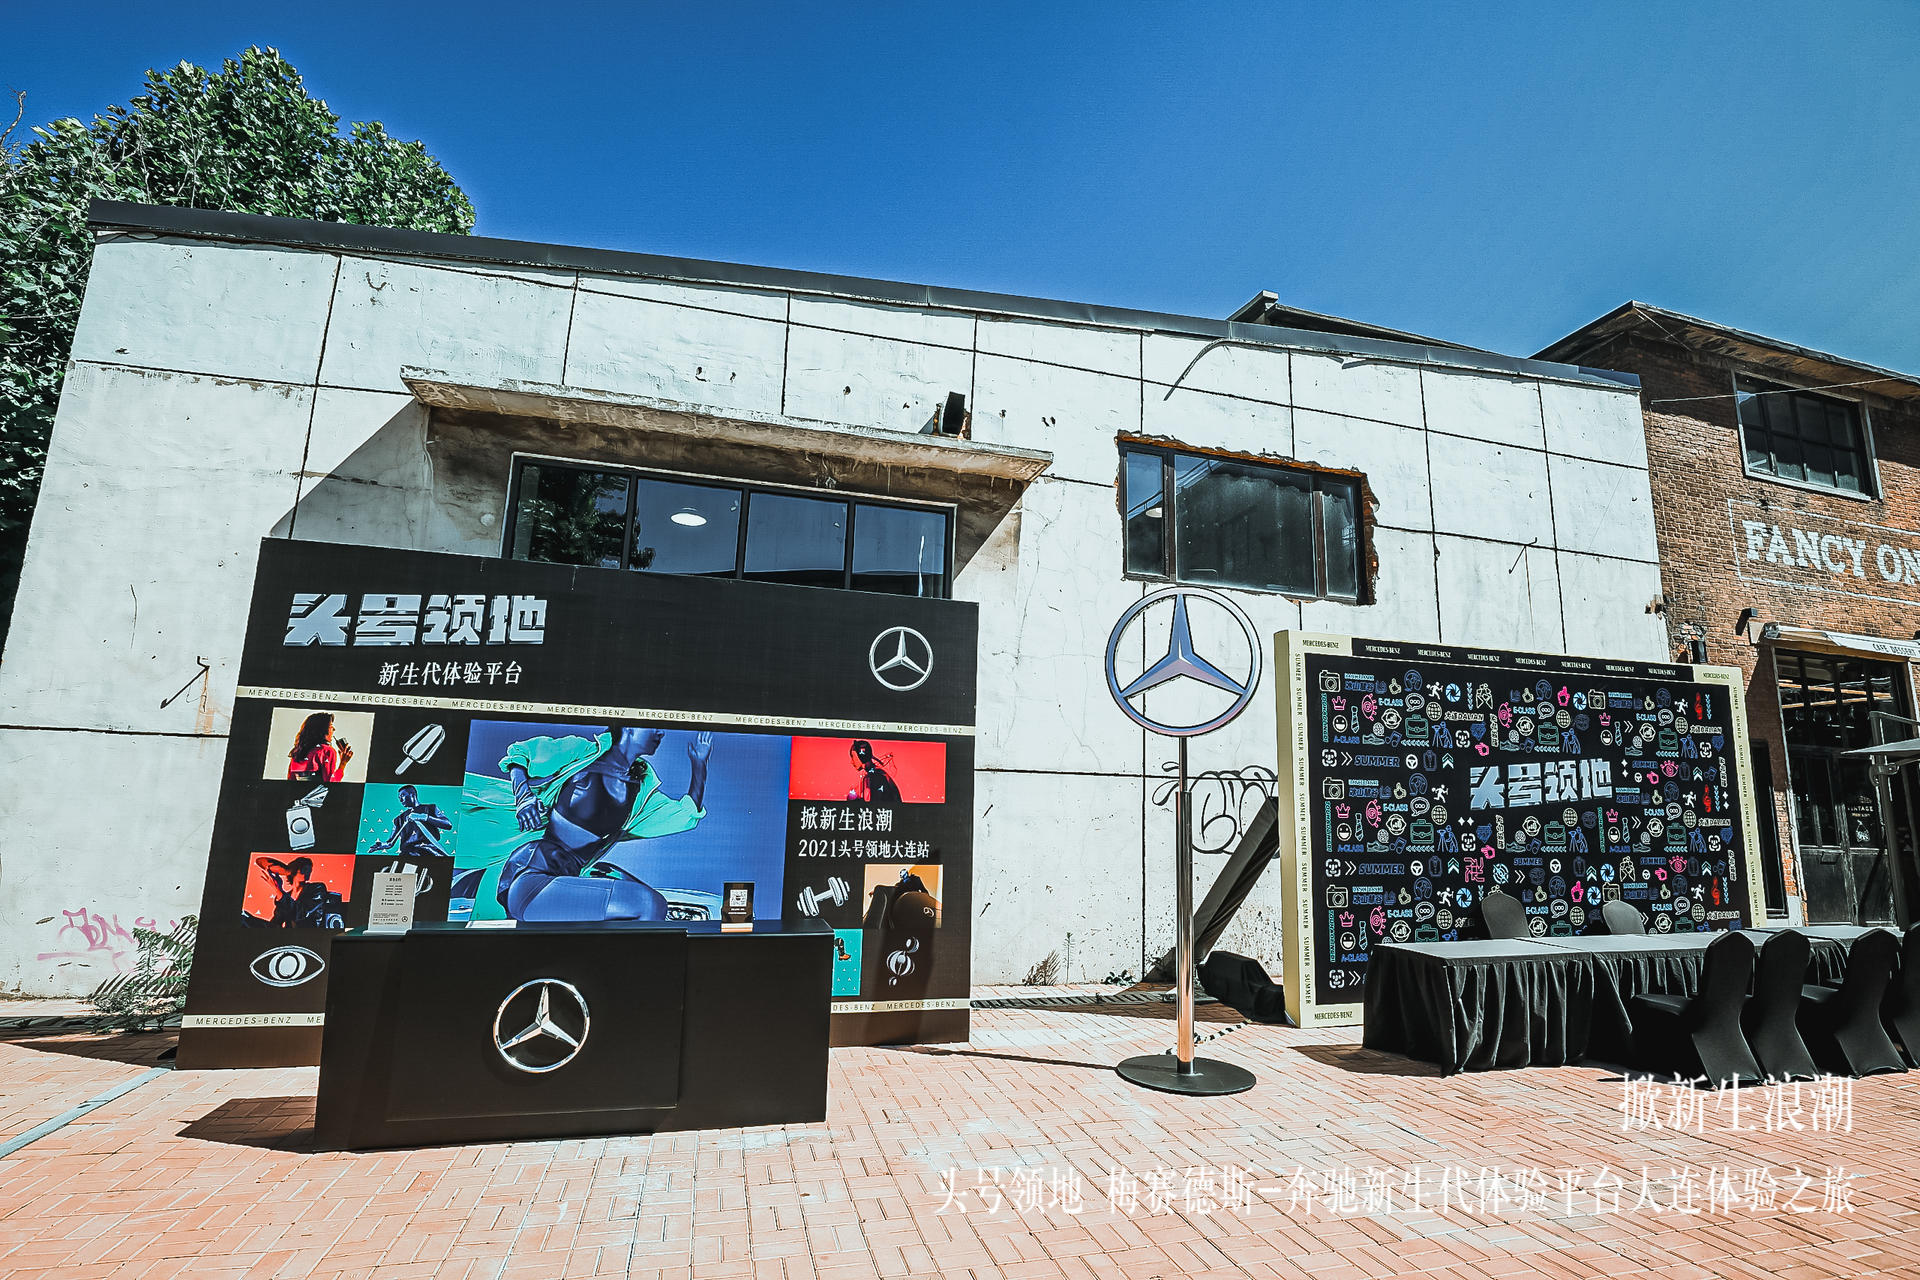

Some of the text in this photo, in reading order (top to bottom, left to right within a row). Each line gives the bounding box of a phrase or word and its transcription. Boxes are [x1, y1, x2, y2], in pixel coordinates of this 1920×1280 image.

[1741, 519, 1867, 578] FANCY
[283, 593, 548, 647] 头号领地
[377, 661, 523, 687] 新生代体验平台
[248, 688, 338, 701] MERCEDES-BENZ
[352, 695, 438, 706] MERCEDES-BENZ
[451, 700, 534, 712] MERCEDES-BENZ
[547, 706, 626, 717] MERCEDES-BENZ
[638, 711, 713, 721] MERCEDES-BENZ
[735, 716, 807, 726] MERCEDES-BENZ
[818, 721, 887, 730] MERCEDES-BENZ
[1354, 755, 1400, 767] SUMMER
[1469, 758, 1613, 811] 头号领地
[1383, 803, 1408, 812] E-CLASS
[800, 805, 893, 832] 掀新生浪潮
[798, 839, 930, 859] 2021头号领地大连站
[1513, 857, 1543, 866] SUMMER
[1358, 863, 1405, 875] SUMMER
[1387, 909, 1413, 918] E-CLASS
[1525, 906, 1549, 915] E-CLASS
[1341, 953, 1369, 963] A-CLASS
[886, 1001, 956, 1009] MERCEDES-BENZ
[195, 1016, 291, 1025] MERCEDES-BENZ
[1314, 1011, 1353, 1020] MERCEDES-BENZ
